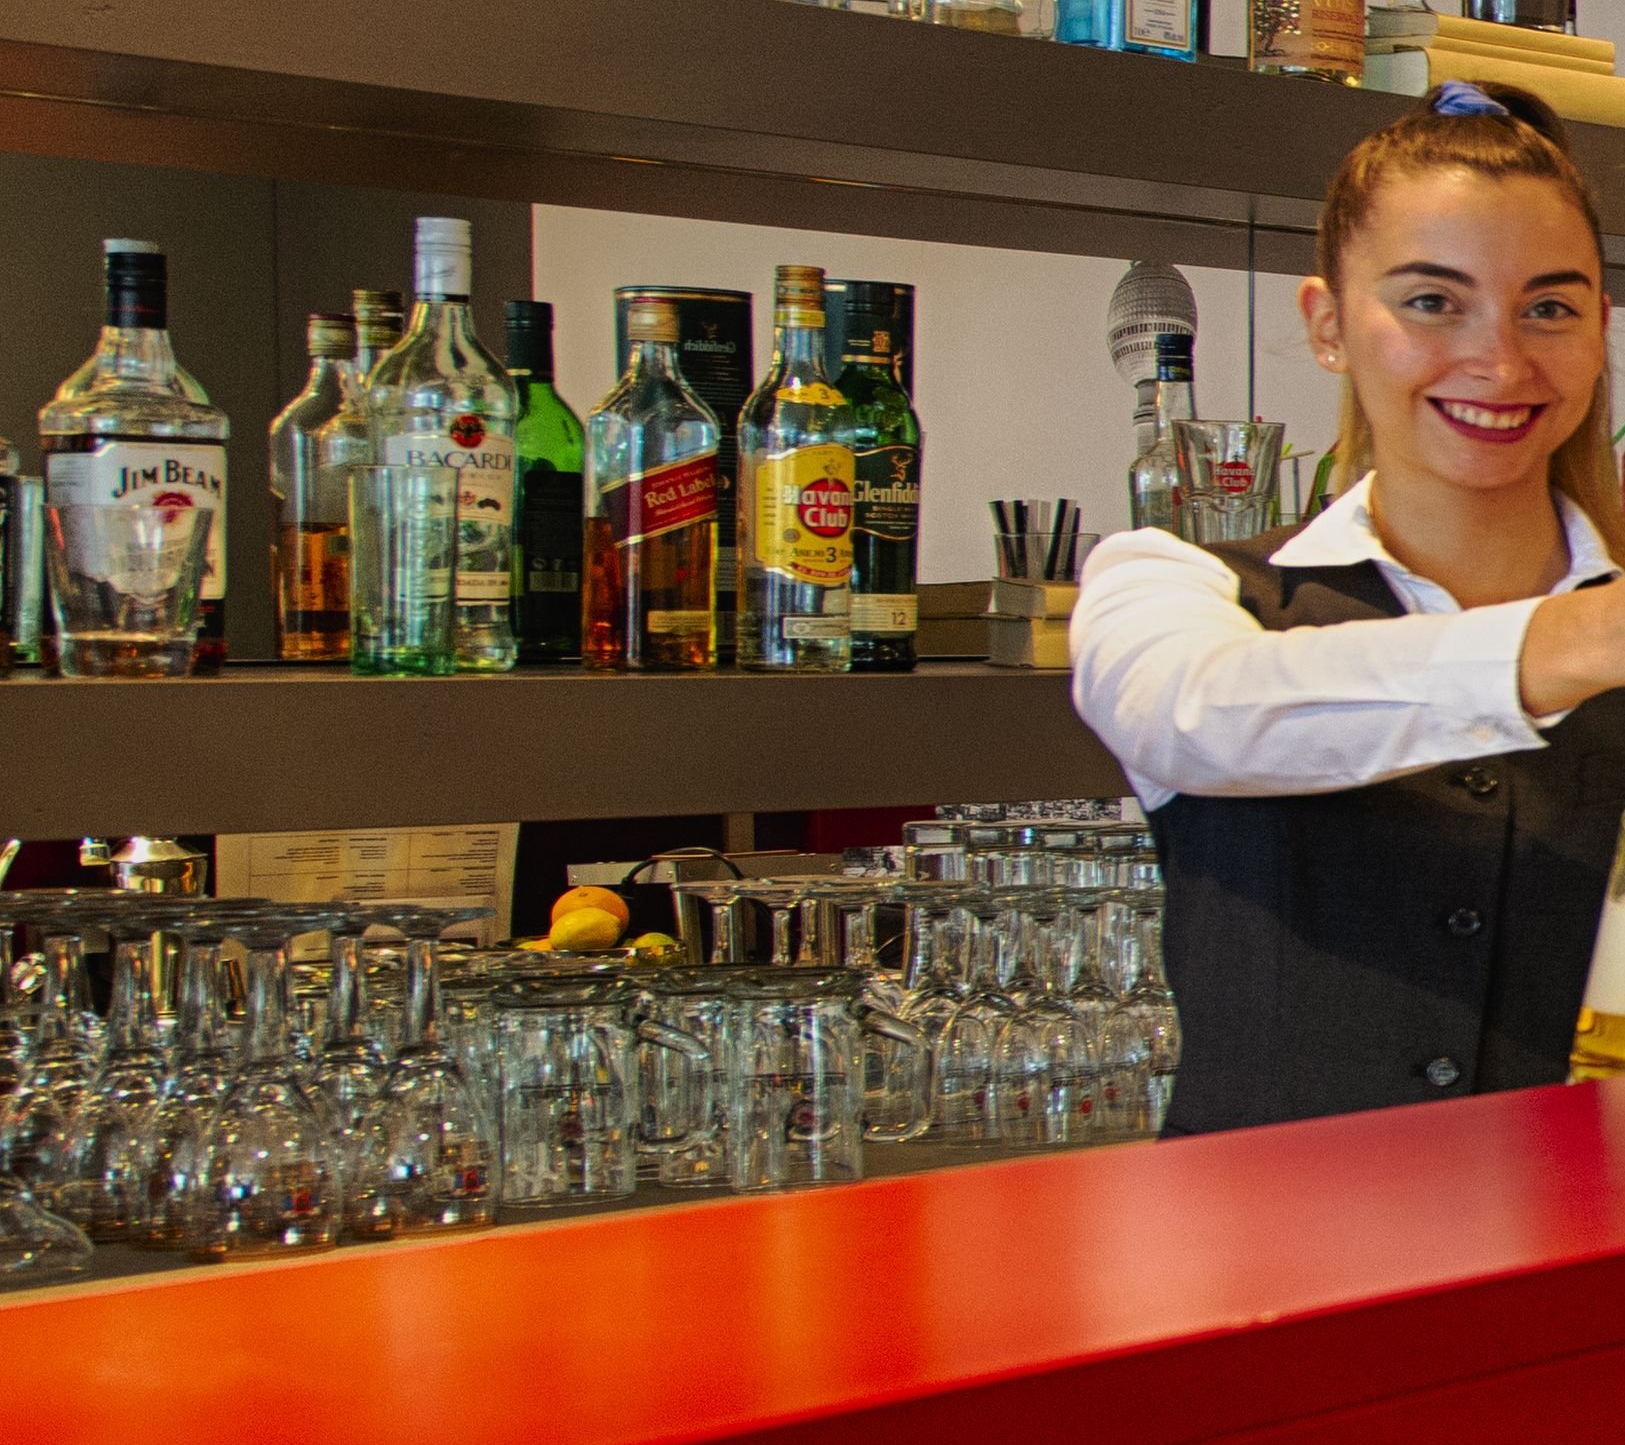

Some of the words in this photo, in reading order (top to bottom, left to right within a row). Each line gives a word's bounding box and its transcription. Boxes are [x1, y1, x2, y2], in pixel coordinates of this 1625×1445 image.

[406, 450, 513, 471] BACARDI
[111, 466, 158, 499] JIM
[164, 459, 222, 500] BEAM
[644, 488, 677, 509] Red
[679, 473, 717, 497] Label
[782, 485, 853, 505] Havan
[853, 480, 918, 503] Glenfidd
[804, 507, 848, 528] Club
[891, 611, 907, 626] 12
